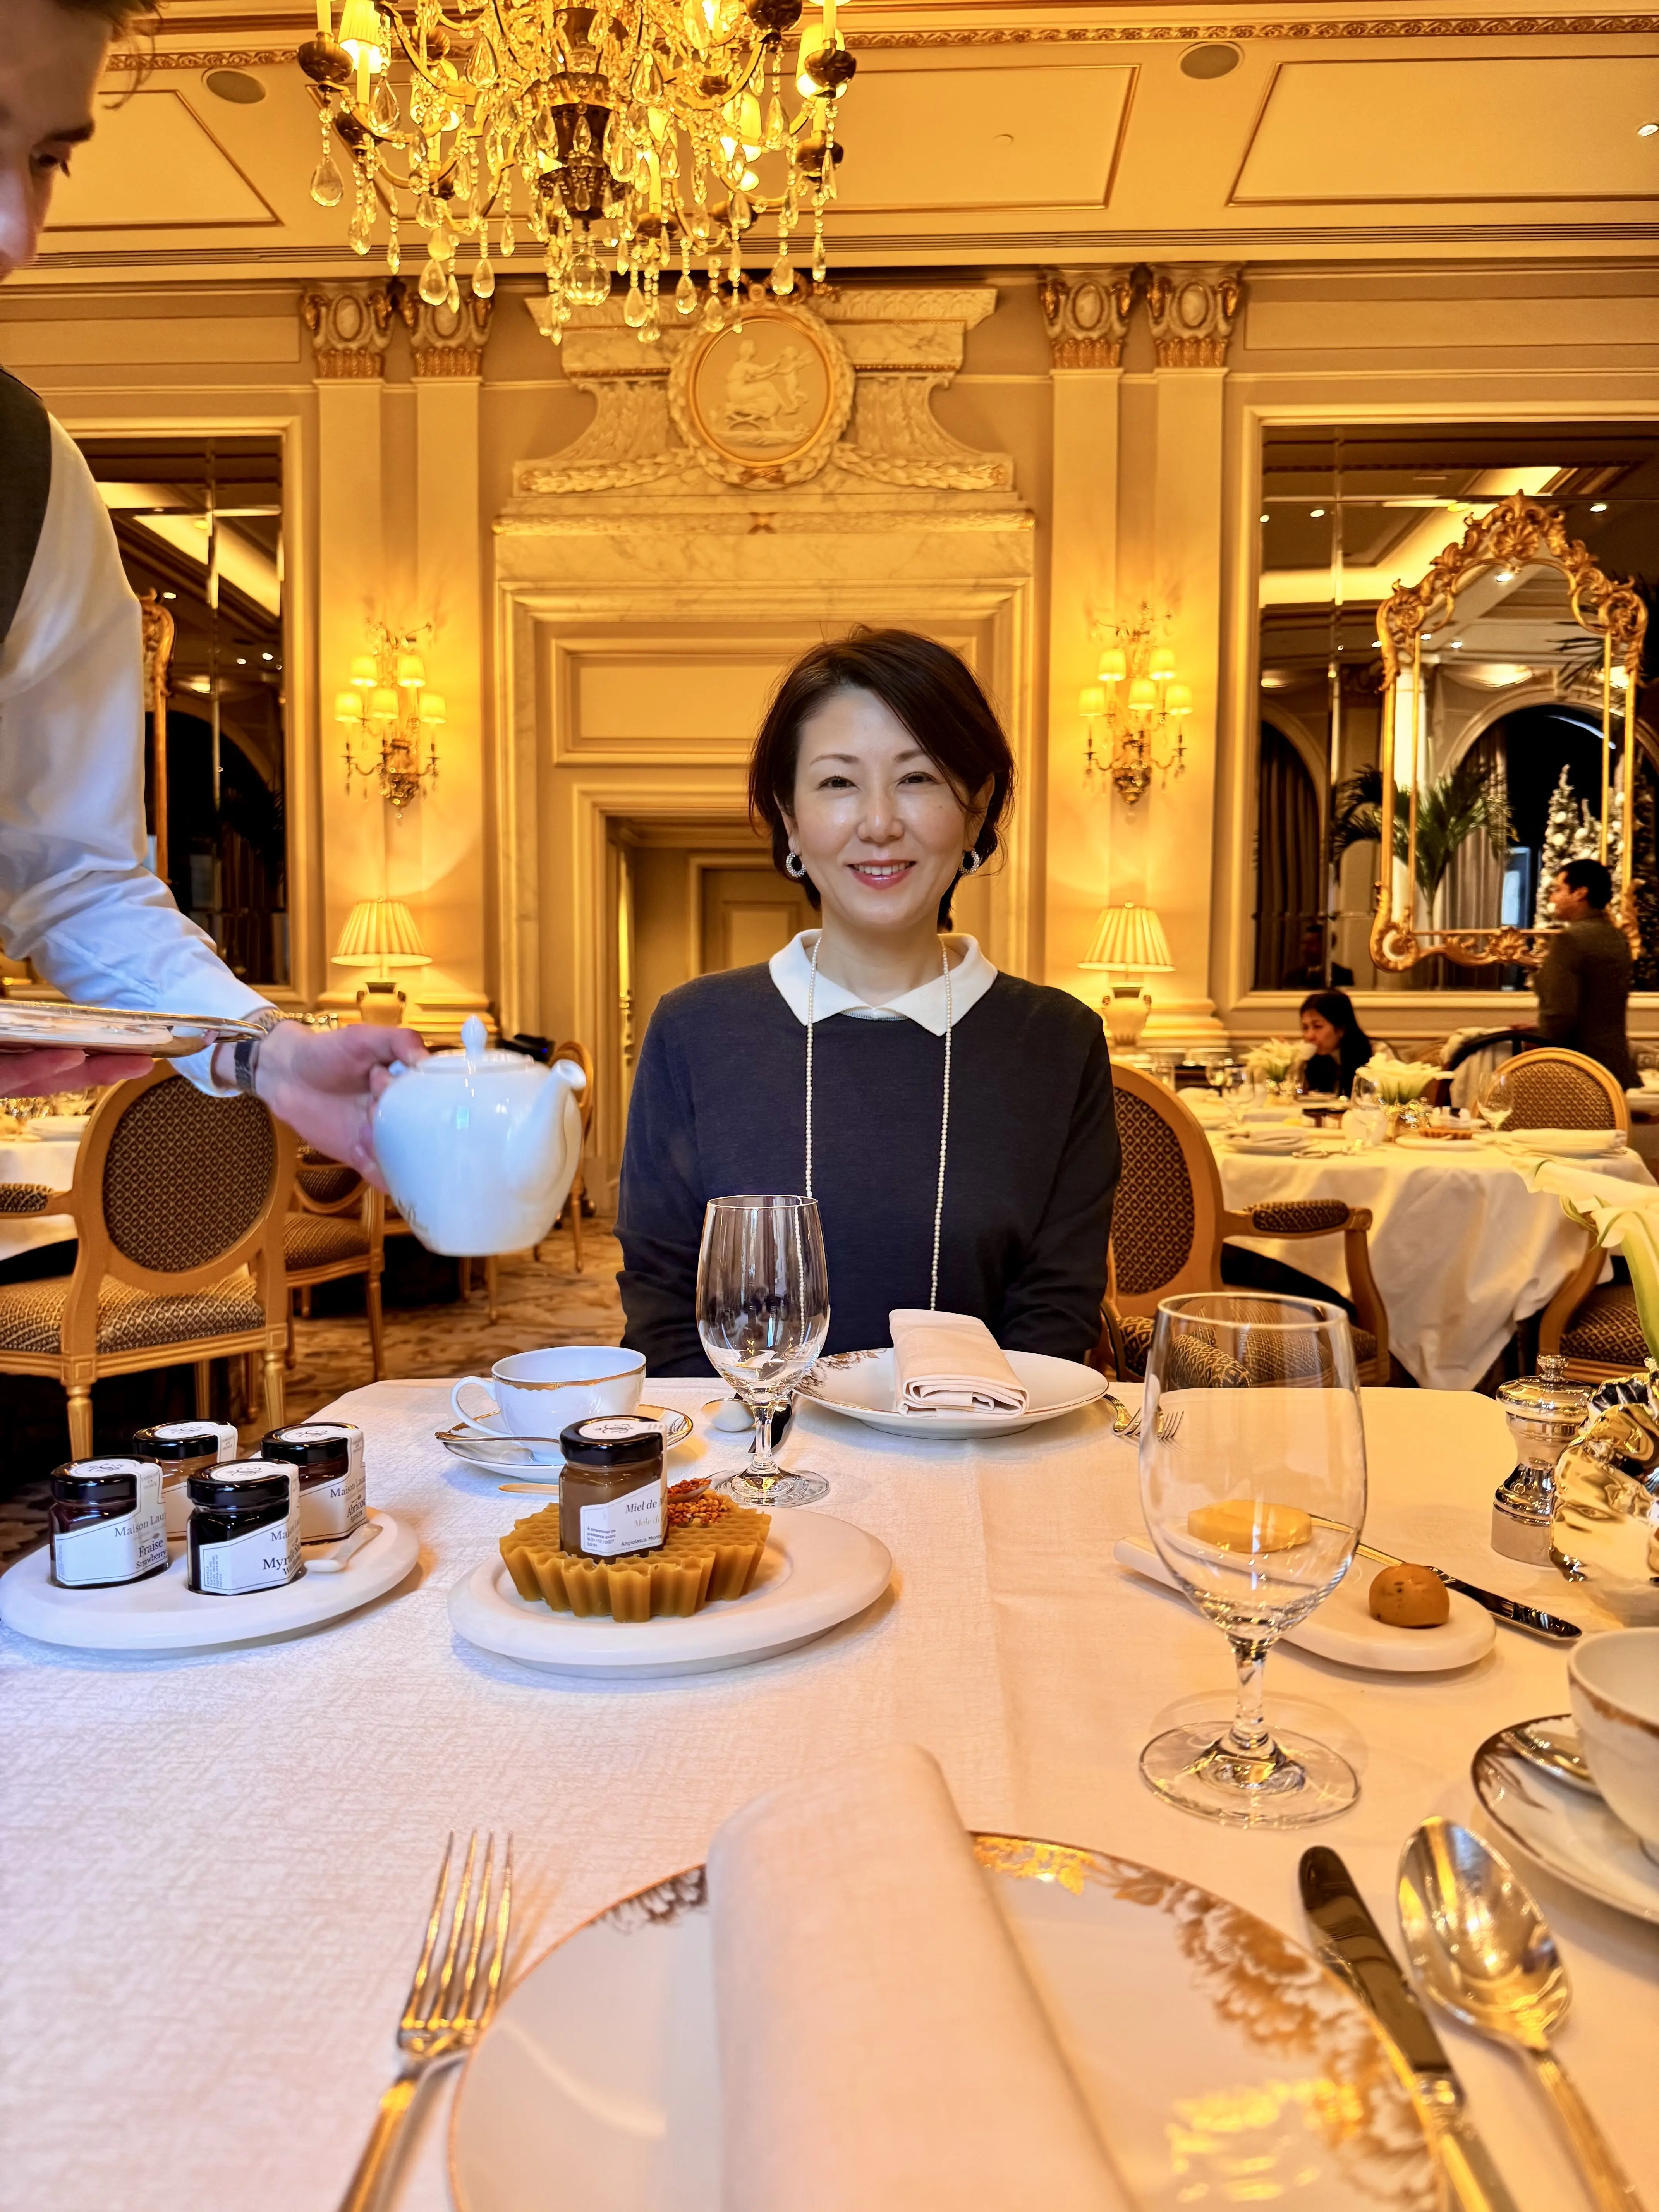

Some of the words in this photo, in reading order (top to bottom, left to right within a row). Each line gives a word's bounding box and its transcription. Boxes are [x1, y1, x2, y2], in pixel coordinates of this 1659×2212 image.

[330, 1483, 355, 1498] Maison
[625, 1501, 644, 1514] Miel
[647, 1499, 657, 1509] de
[115, 1521, 148, 1537] Maison
[635, 1518, 651, 1528] Mele
[653, 1515, 660, 1523] di
[139, 1540, 163, 1558] Fraise
[136, 1550, 167, 1569] Strawberry
